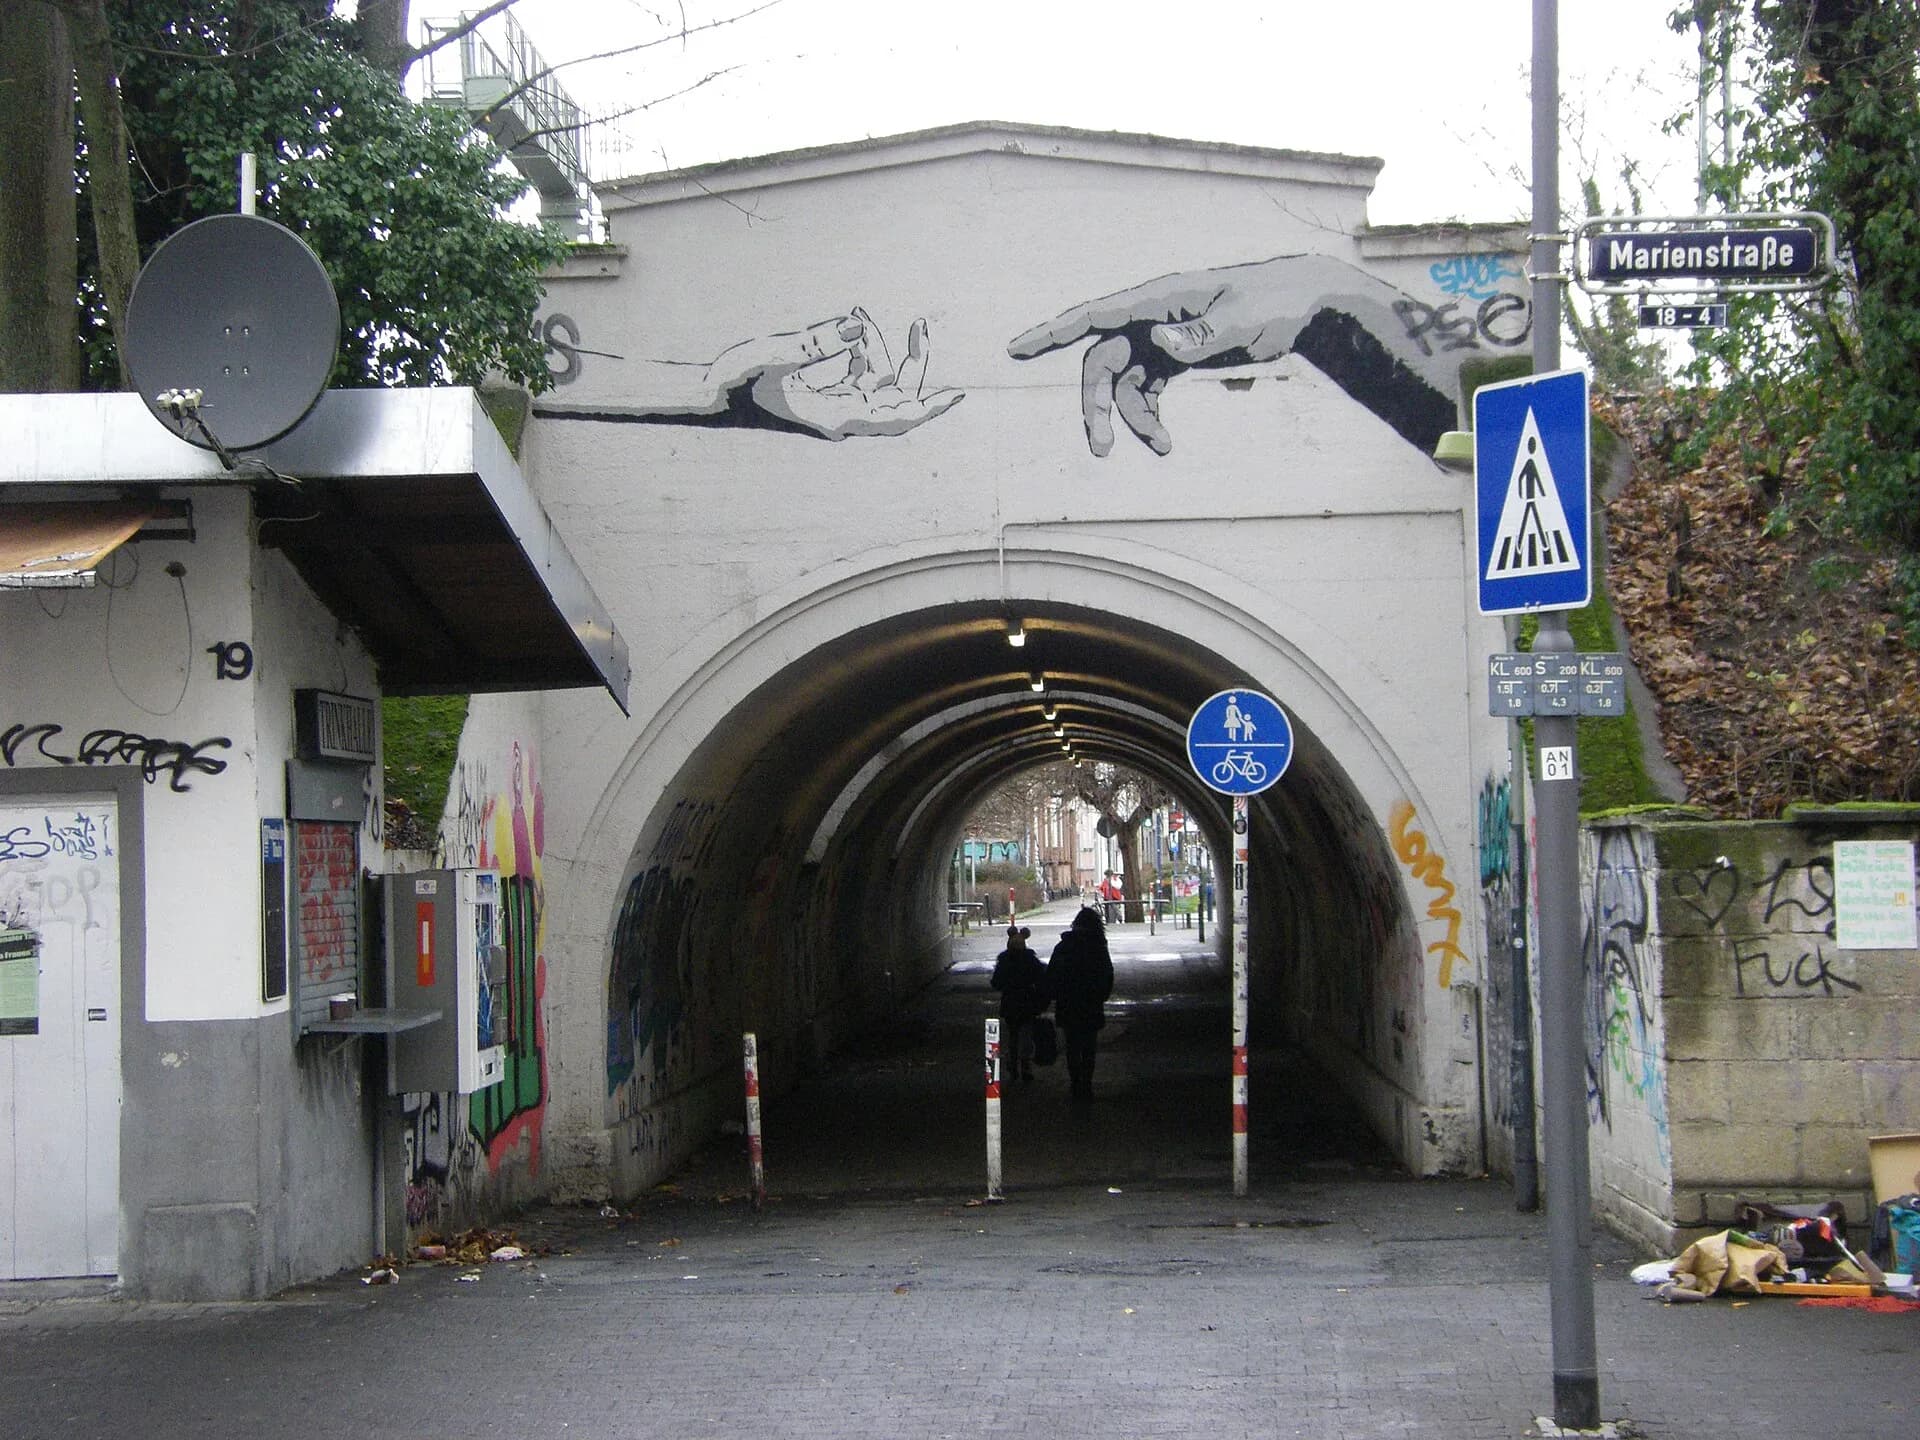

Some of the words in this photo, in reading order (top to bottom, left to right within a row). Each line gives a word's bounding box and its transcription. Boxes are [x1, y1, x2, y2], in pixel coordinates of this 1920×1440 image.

[1609, 235, 1794, 271] Marienstraße
[206, 641, 252, 680] 19
[1490, 662, 1510, 676] KL
[1535, 661, 1546, 675] S
[1559, 665, 1577, 675] 200
[1580, 661, 1601, 676] KL
[1546, 751, 1569, 763] AN
[1547, 763, 1568, 776] 01
